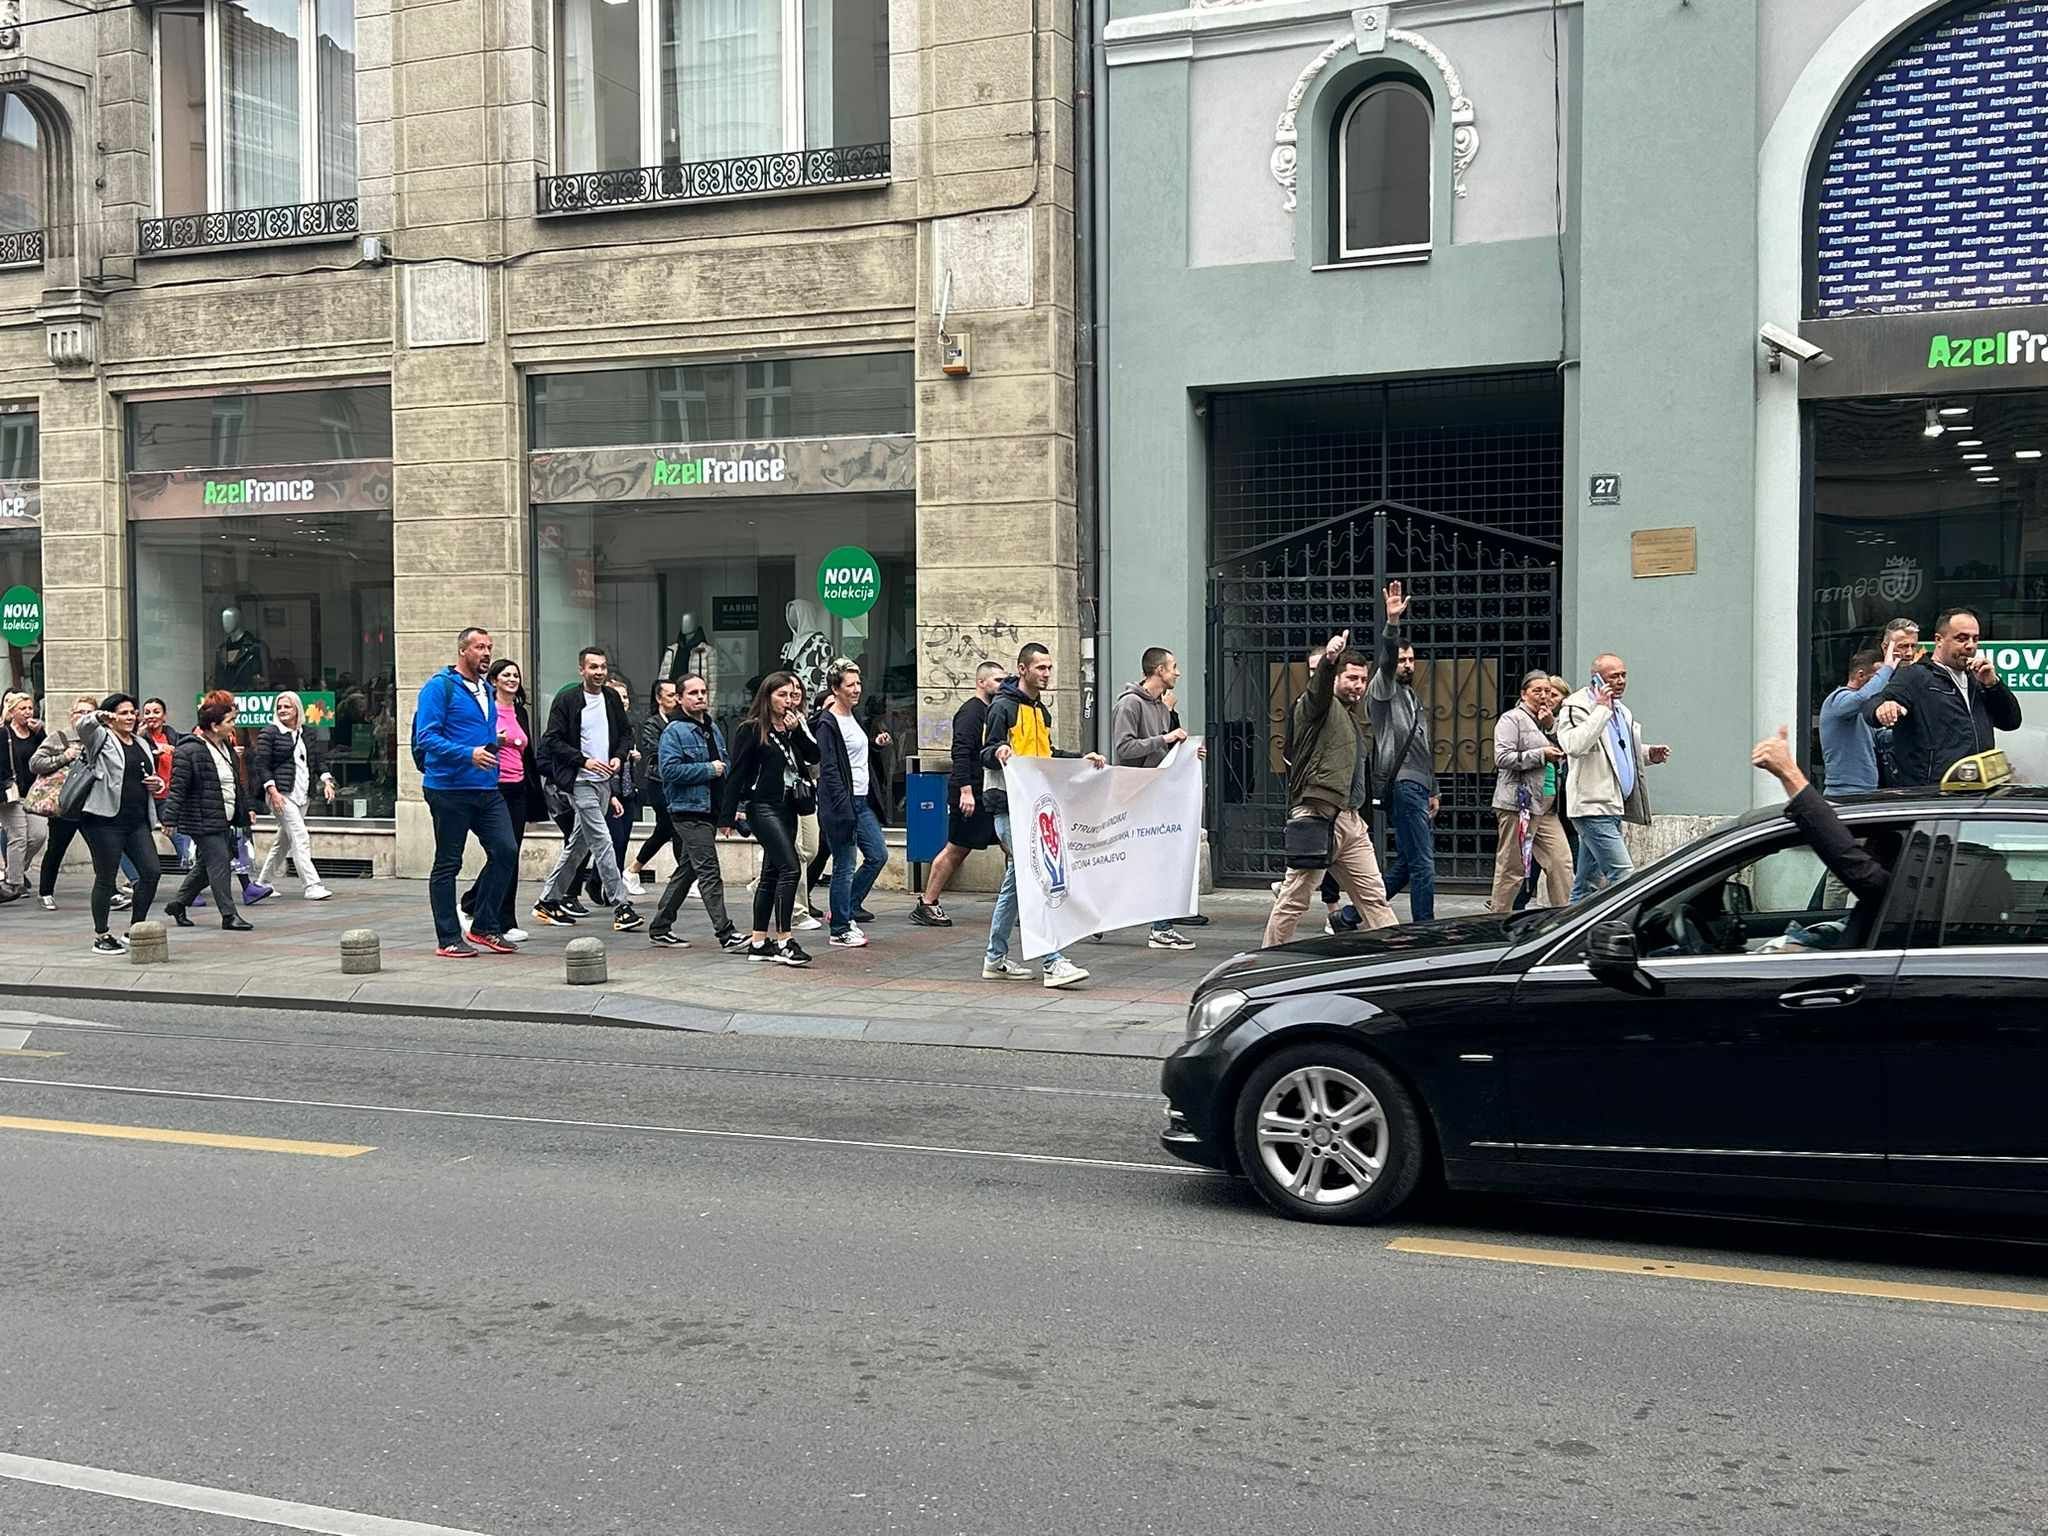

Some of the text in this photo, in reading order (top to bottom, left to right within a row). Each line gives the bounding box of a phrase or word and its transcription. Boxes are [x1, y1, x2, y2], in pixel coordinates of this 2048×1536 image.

[653, 458, 784, 485] AzelFrance
[204, 479, 314, 504] AzelFrance
[1596, 479, 1615, 494] 27
[825, 568, 873, 584] NOVA
[824, 586, 874, 601] kolekcija
[3, 604, 38, 618] NOVA
[3, 619, 39, 632] kolekcija
[1976, 649, 2048, 670] NOV
[234, 696, 274, 712] NOV
[1136, 824, 1182, 838] TEHNIČARA
[1092, 851, 1126, 866] SARAJEVO
